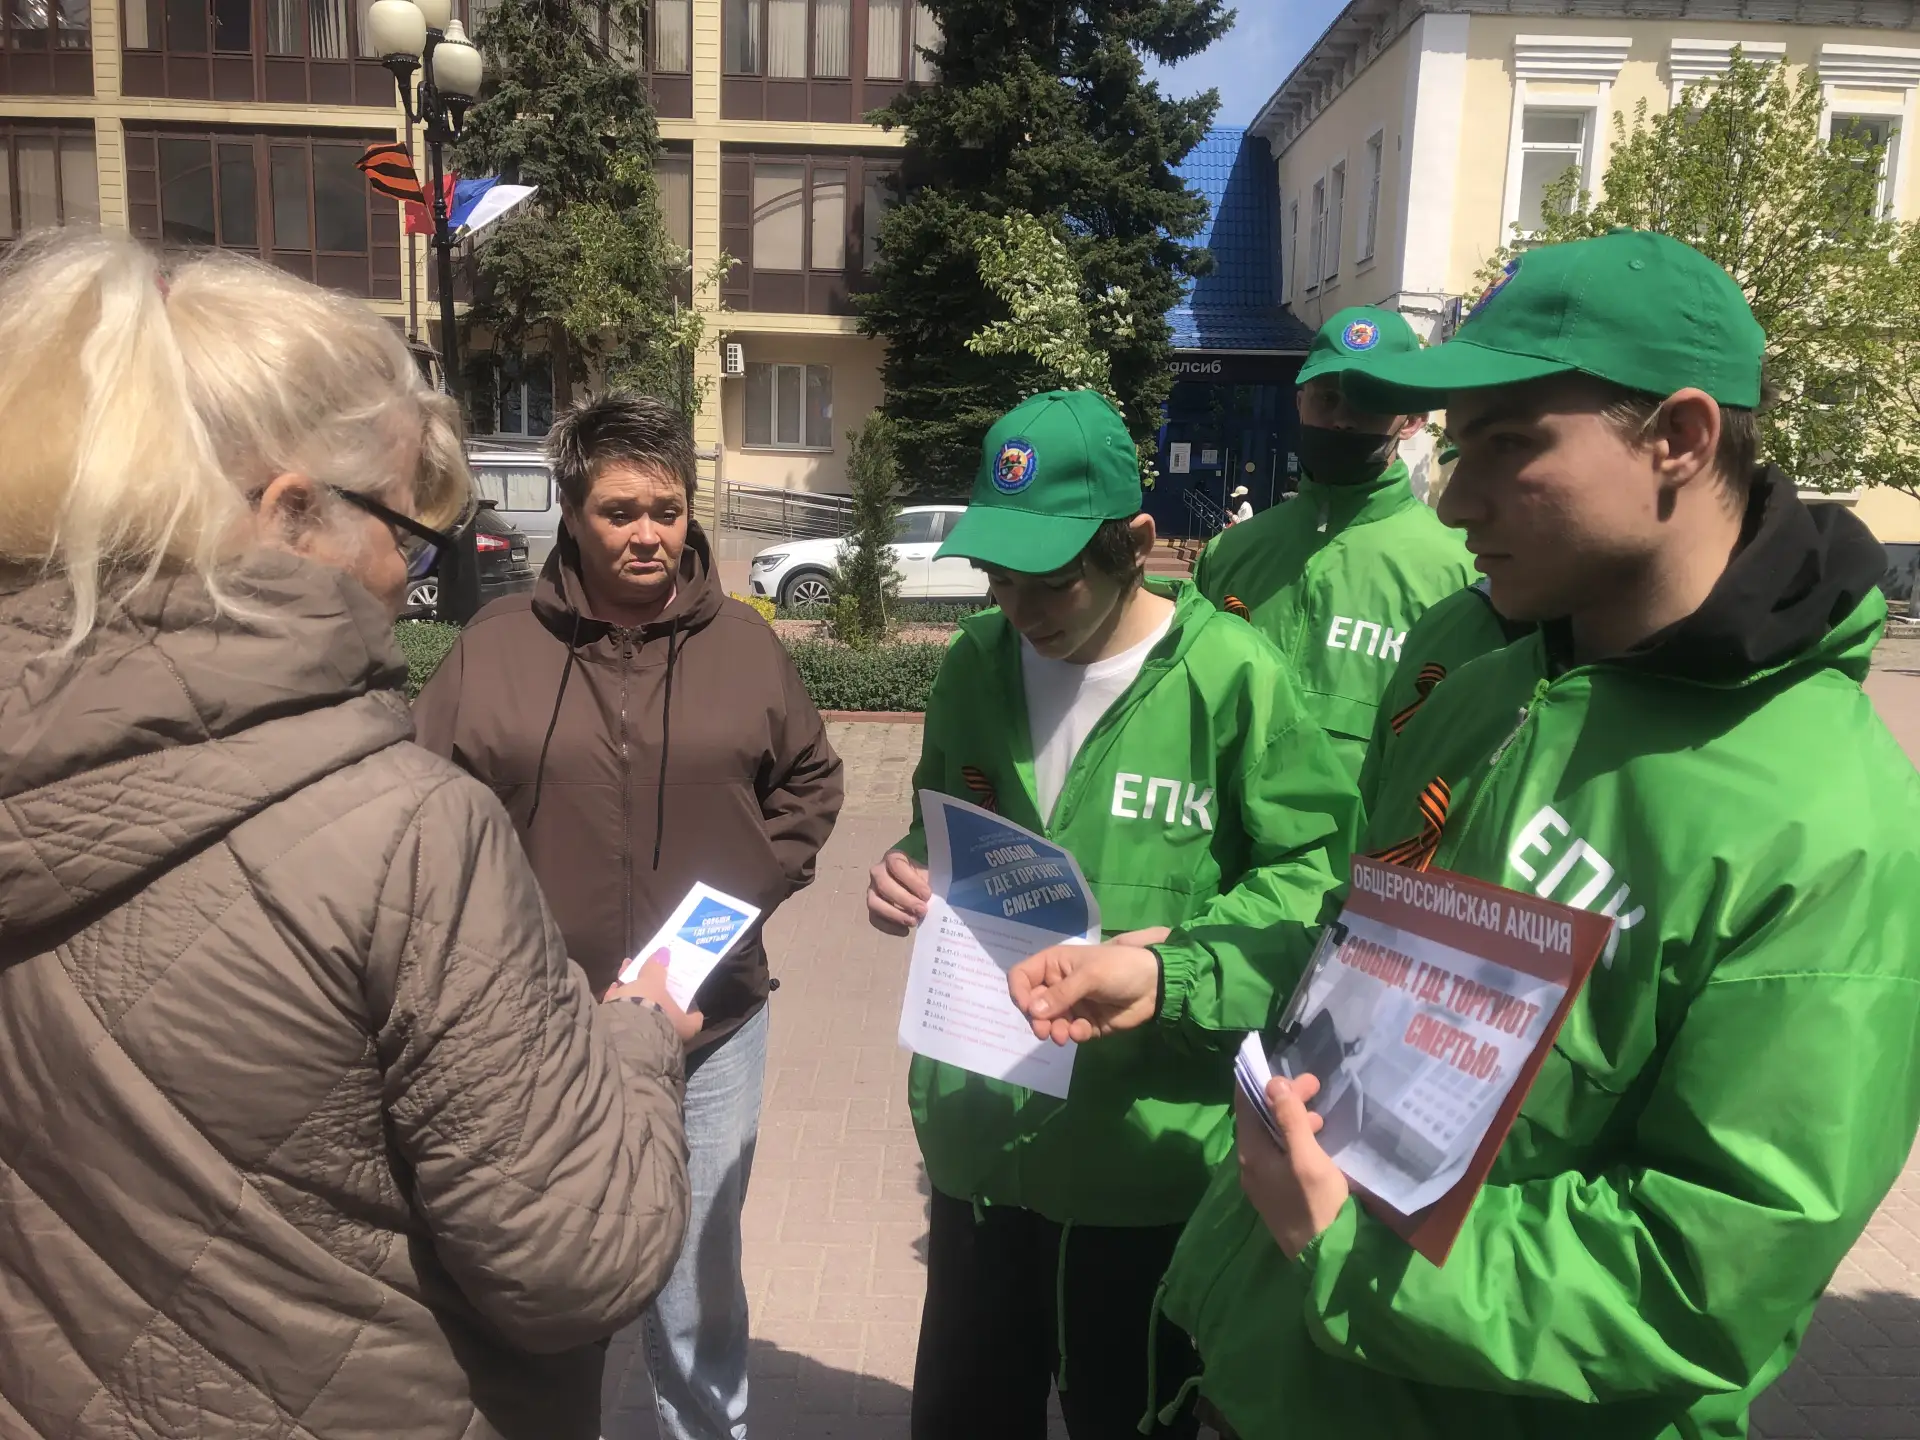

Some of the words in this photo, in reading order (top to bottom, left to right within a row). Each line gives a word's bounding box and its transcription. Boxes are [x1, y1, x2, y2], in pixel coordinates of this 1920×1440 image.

[1326, 615, 1407, 663] ЕПК
[1111, 772, 1215, 831] ЕПК
[984, 872, 1013, 897] ГДЕ
[1011, 863, 1064, 886] ТОРГУЮТ
[1002, 882, 1077, 917] СМЕРТЬЮ!
[1353, 863, 1501, 932] ОБЩЕРОССИЙСКАЯ
[1505, 906, 1573, 956] АКЦИЯ
[1509, 805, 1646, 971] ЕПК
[1410, 960, 1450, 1005] ГДЕ
[1446, 973, 1541, 1039] ТОРГУЮТ
